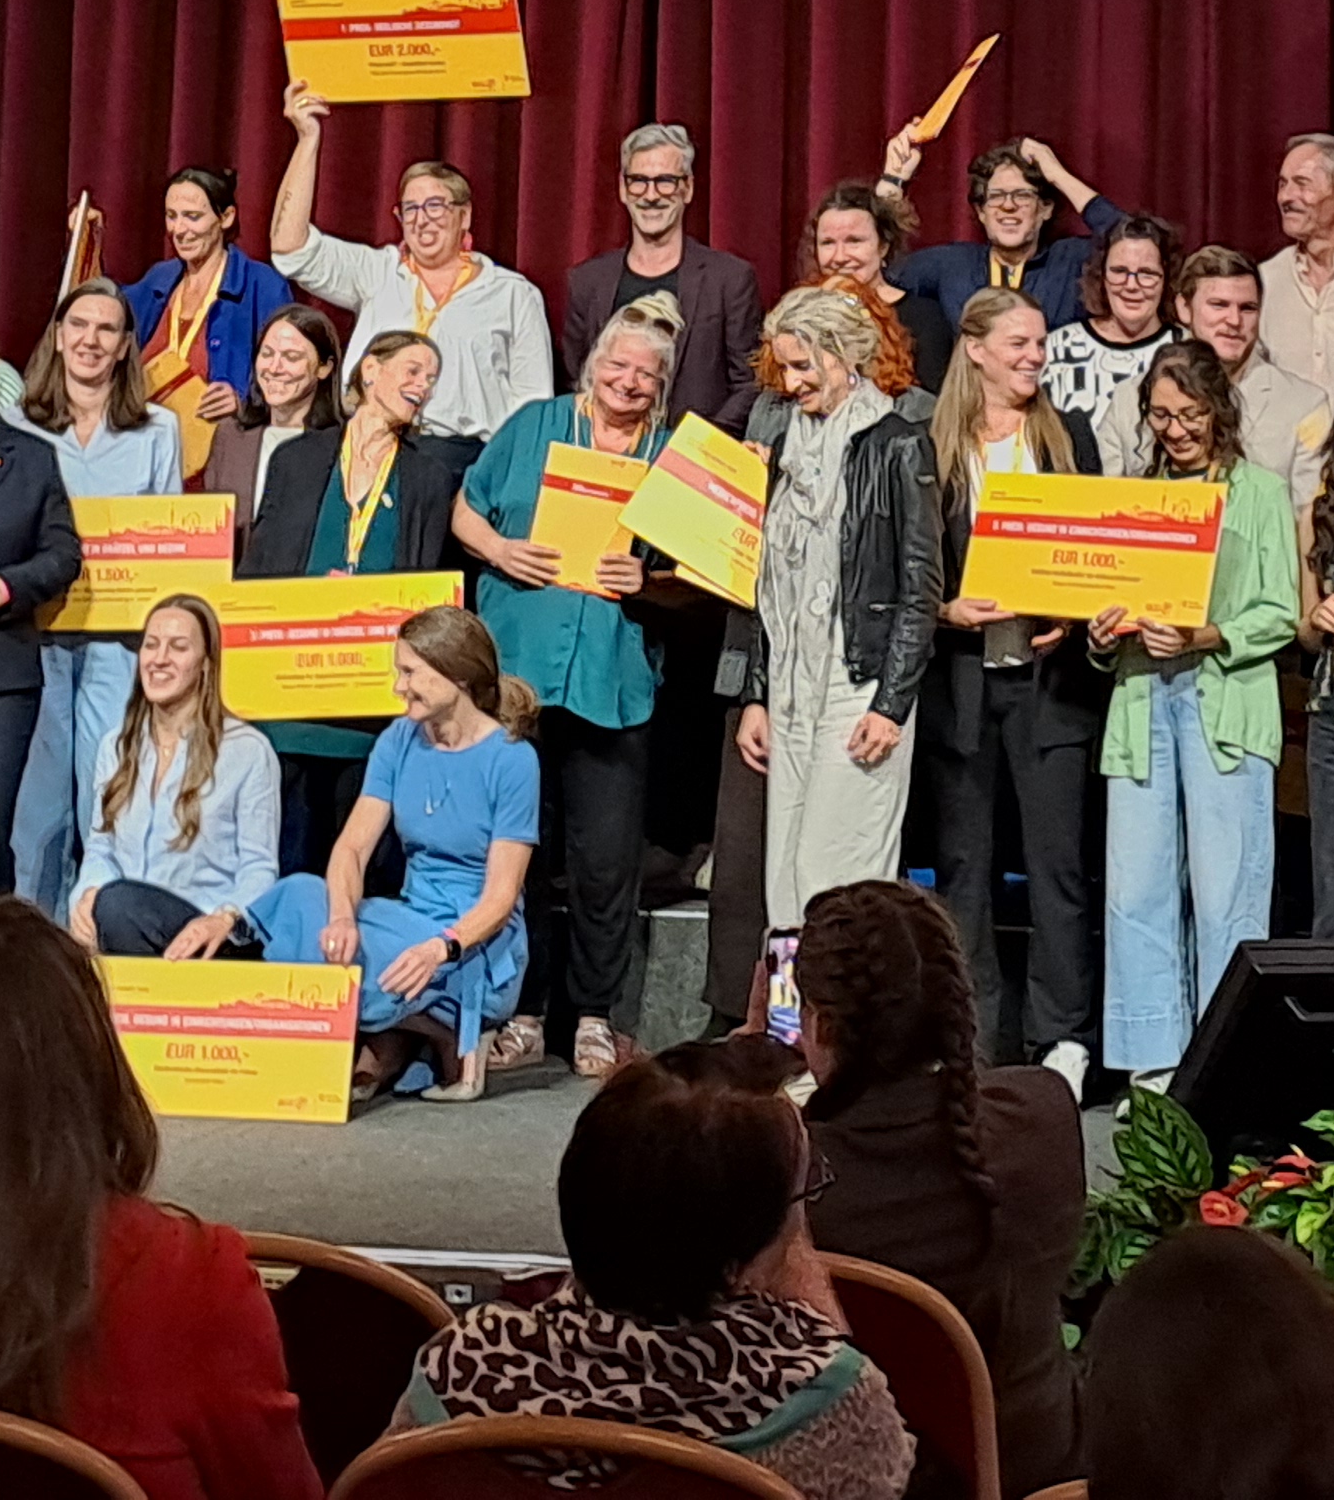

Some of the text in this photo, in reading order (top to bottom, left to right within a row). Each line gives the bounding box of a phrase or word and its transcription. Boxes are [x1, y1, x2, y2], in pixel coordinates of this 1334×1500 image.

[369, 44, 393, 57] EUR
[731, 527, 759, 551] EUR
[1051, 549, 1078, 565] EUR
[165, 1042, 196, 1060] EUR
